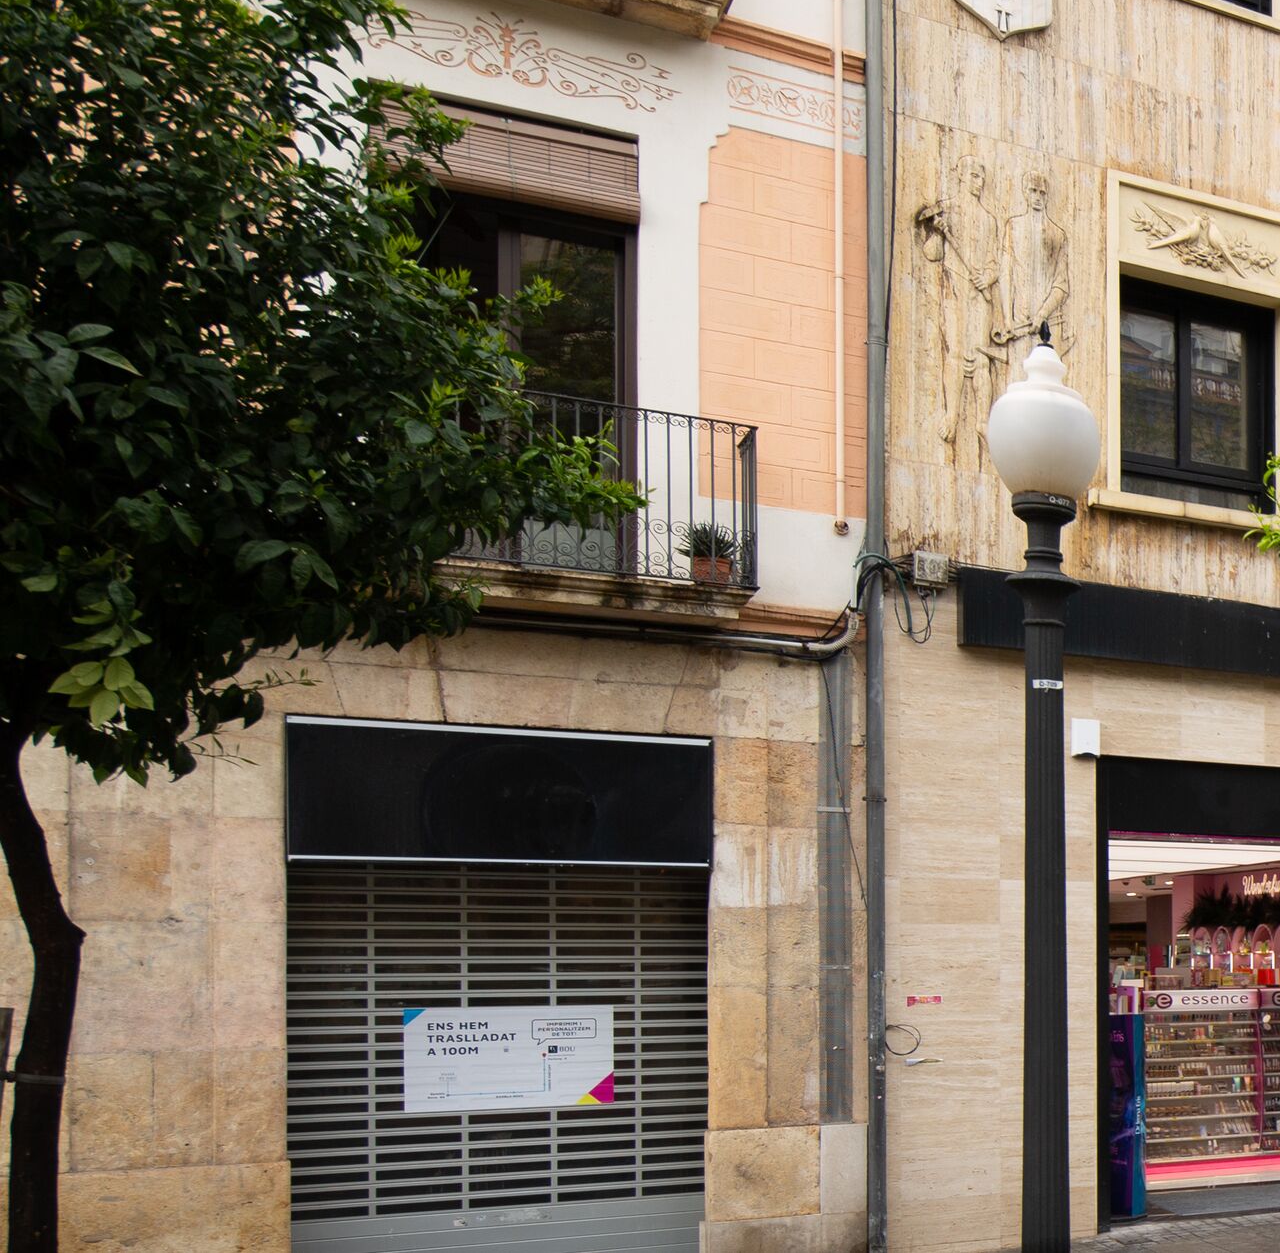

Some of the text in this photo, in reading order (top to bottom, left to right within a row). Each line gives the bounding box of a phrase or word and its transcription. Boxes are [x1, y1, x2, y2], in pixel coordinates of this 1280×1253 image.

[1181, 993, 1249, 1005] essence
[427, 1021, 489, 1031] ENS HEM
[427, 1033, 517, 1043] TRASLLADAT
[427, 1046, 479, 1056] A 100M
